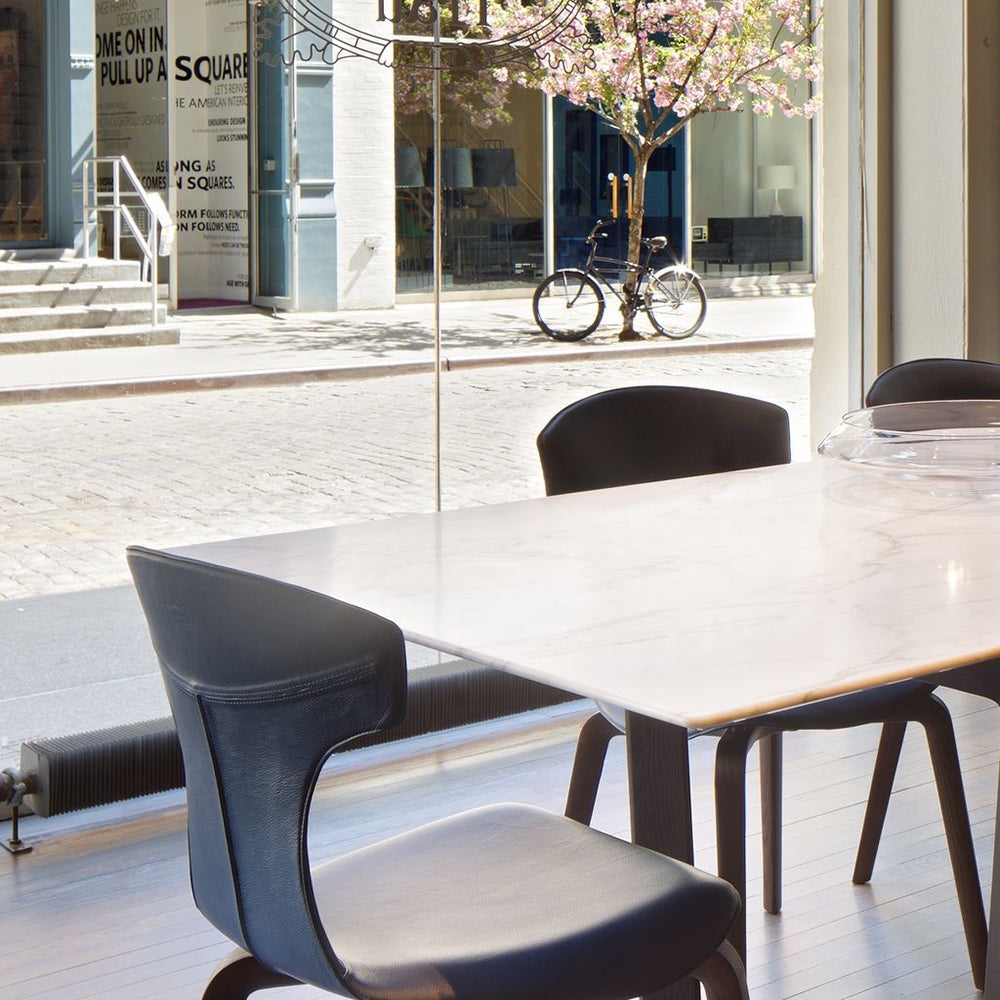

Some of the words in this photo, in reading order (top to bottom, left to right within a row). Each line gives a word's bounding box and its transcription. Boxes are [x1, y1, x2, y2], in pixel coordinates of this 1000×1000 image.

[116, 11, 140, 27] DESIGN
[140, 9, 153, 24] FOR
[125, 29, 146, 55] ON
[101, 60, 132, 86] PULL
[135, 56, 154, 83] UP
[157, 56, 167, 82] A
[188, 97, 227, 109] AMERICAN
[230, 117, 246, 126] DESIGN
[156, 160, 165, 172] AS
[206, 160, 216, 172] AS
[141, 177, 166, 190] COMES
[187, 176, 235, 191] SQUARES.
[201, 209, 229, 219] FOLLOWS
[192, 222, 224, 232] FOLLOWS
